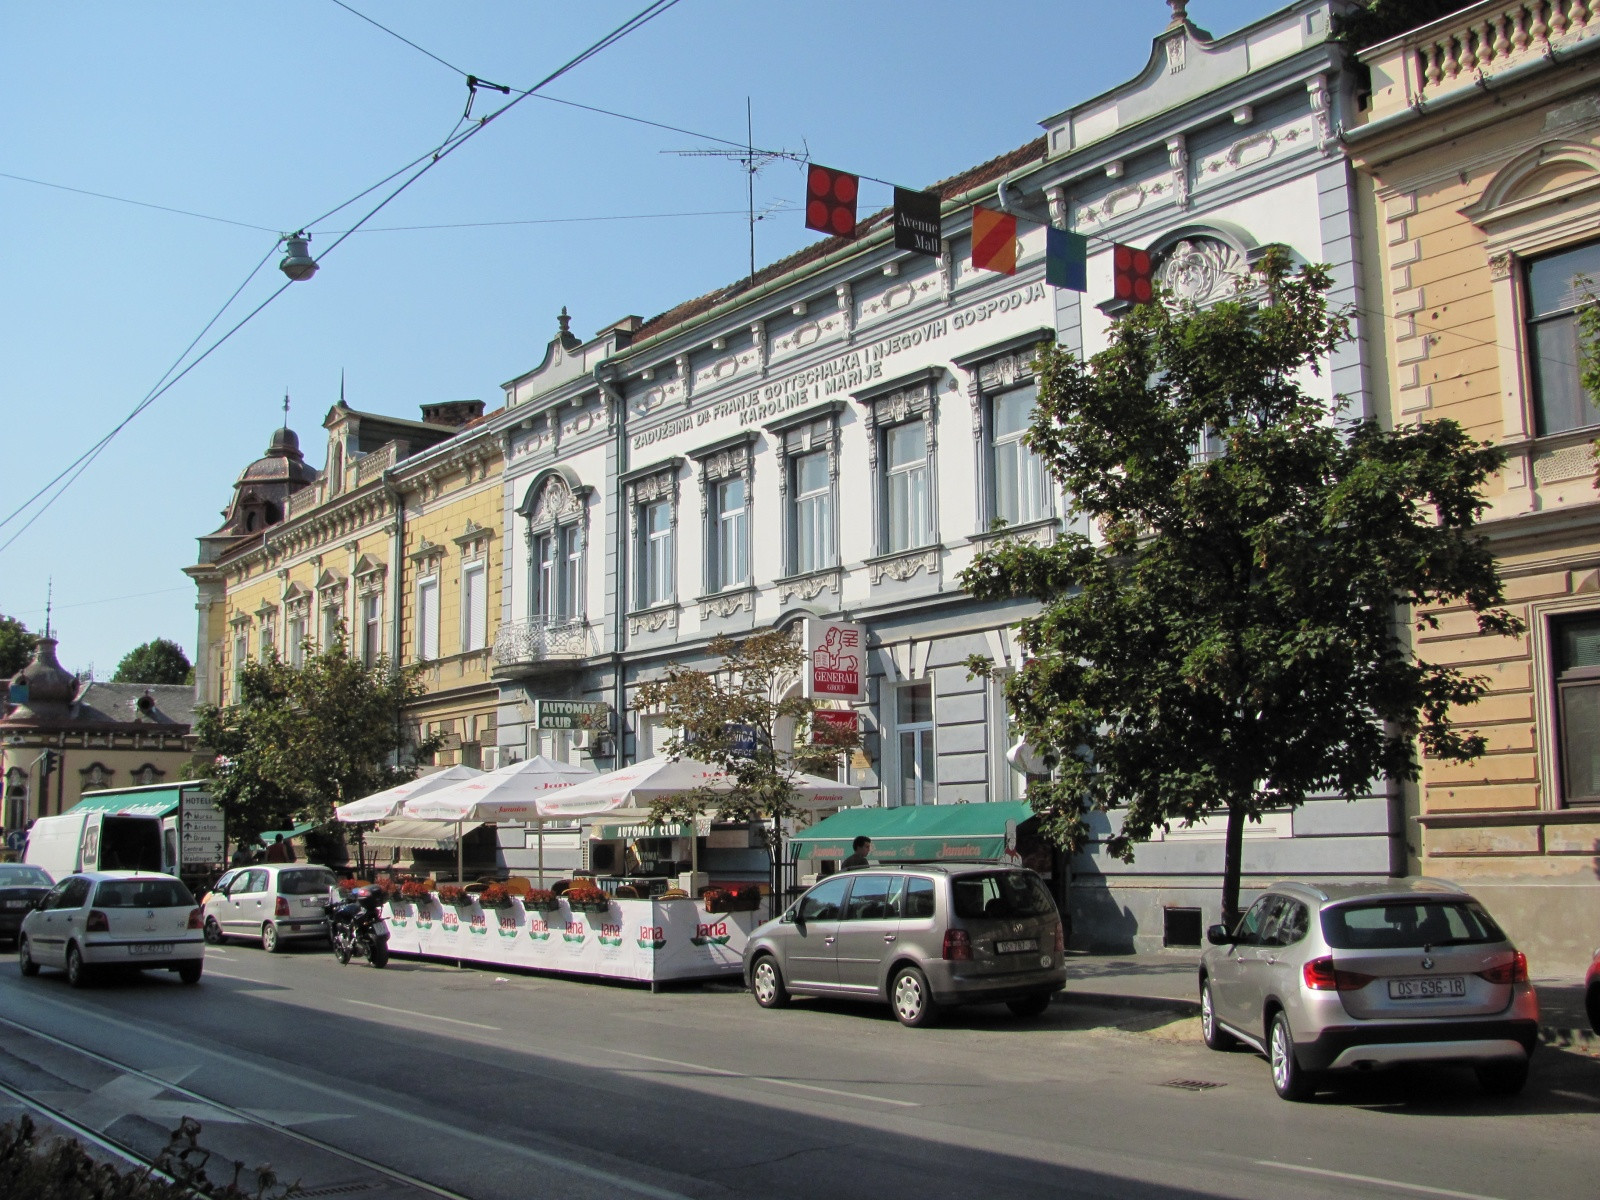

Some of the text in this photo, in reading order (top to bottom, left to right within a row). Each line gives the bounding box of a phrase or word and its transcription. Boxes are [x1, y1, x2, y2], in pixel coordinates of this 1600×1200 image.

[897, 212, 938, 233] Avenue
[914, 233, 939, 252] Mall
[633, 416, 694, 450] ZADUŽBINA
[713, 390, 760, 420] FRANJE
[764, 352, 861, 400] GOTTSCHALKA
[864, 352, 870, 363] I
[872, 318, 948, 361] NJEGOVIH
[951, 281, 1046, 331] GOSPODJA
[739, 361, 883, 426] KAROLINE I MARIJE
[814, 670, 858, 684] GENERALI
[826, 684, 846, 692] GROUP
[542, 702, 597, 714] AUTOMAT
[541, 716, 572, 728] CLUB
[617, 823, 681, 837] AUTOMAT CLUB
[1398, 980, 1462, 994] OS 696-IR
